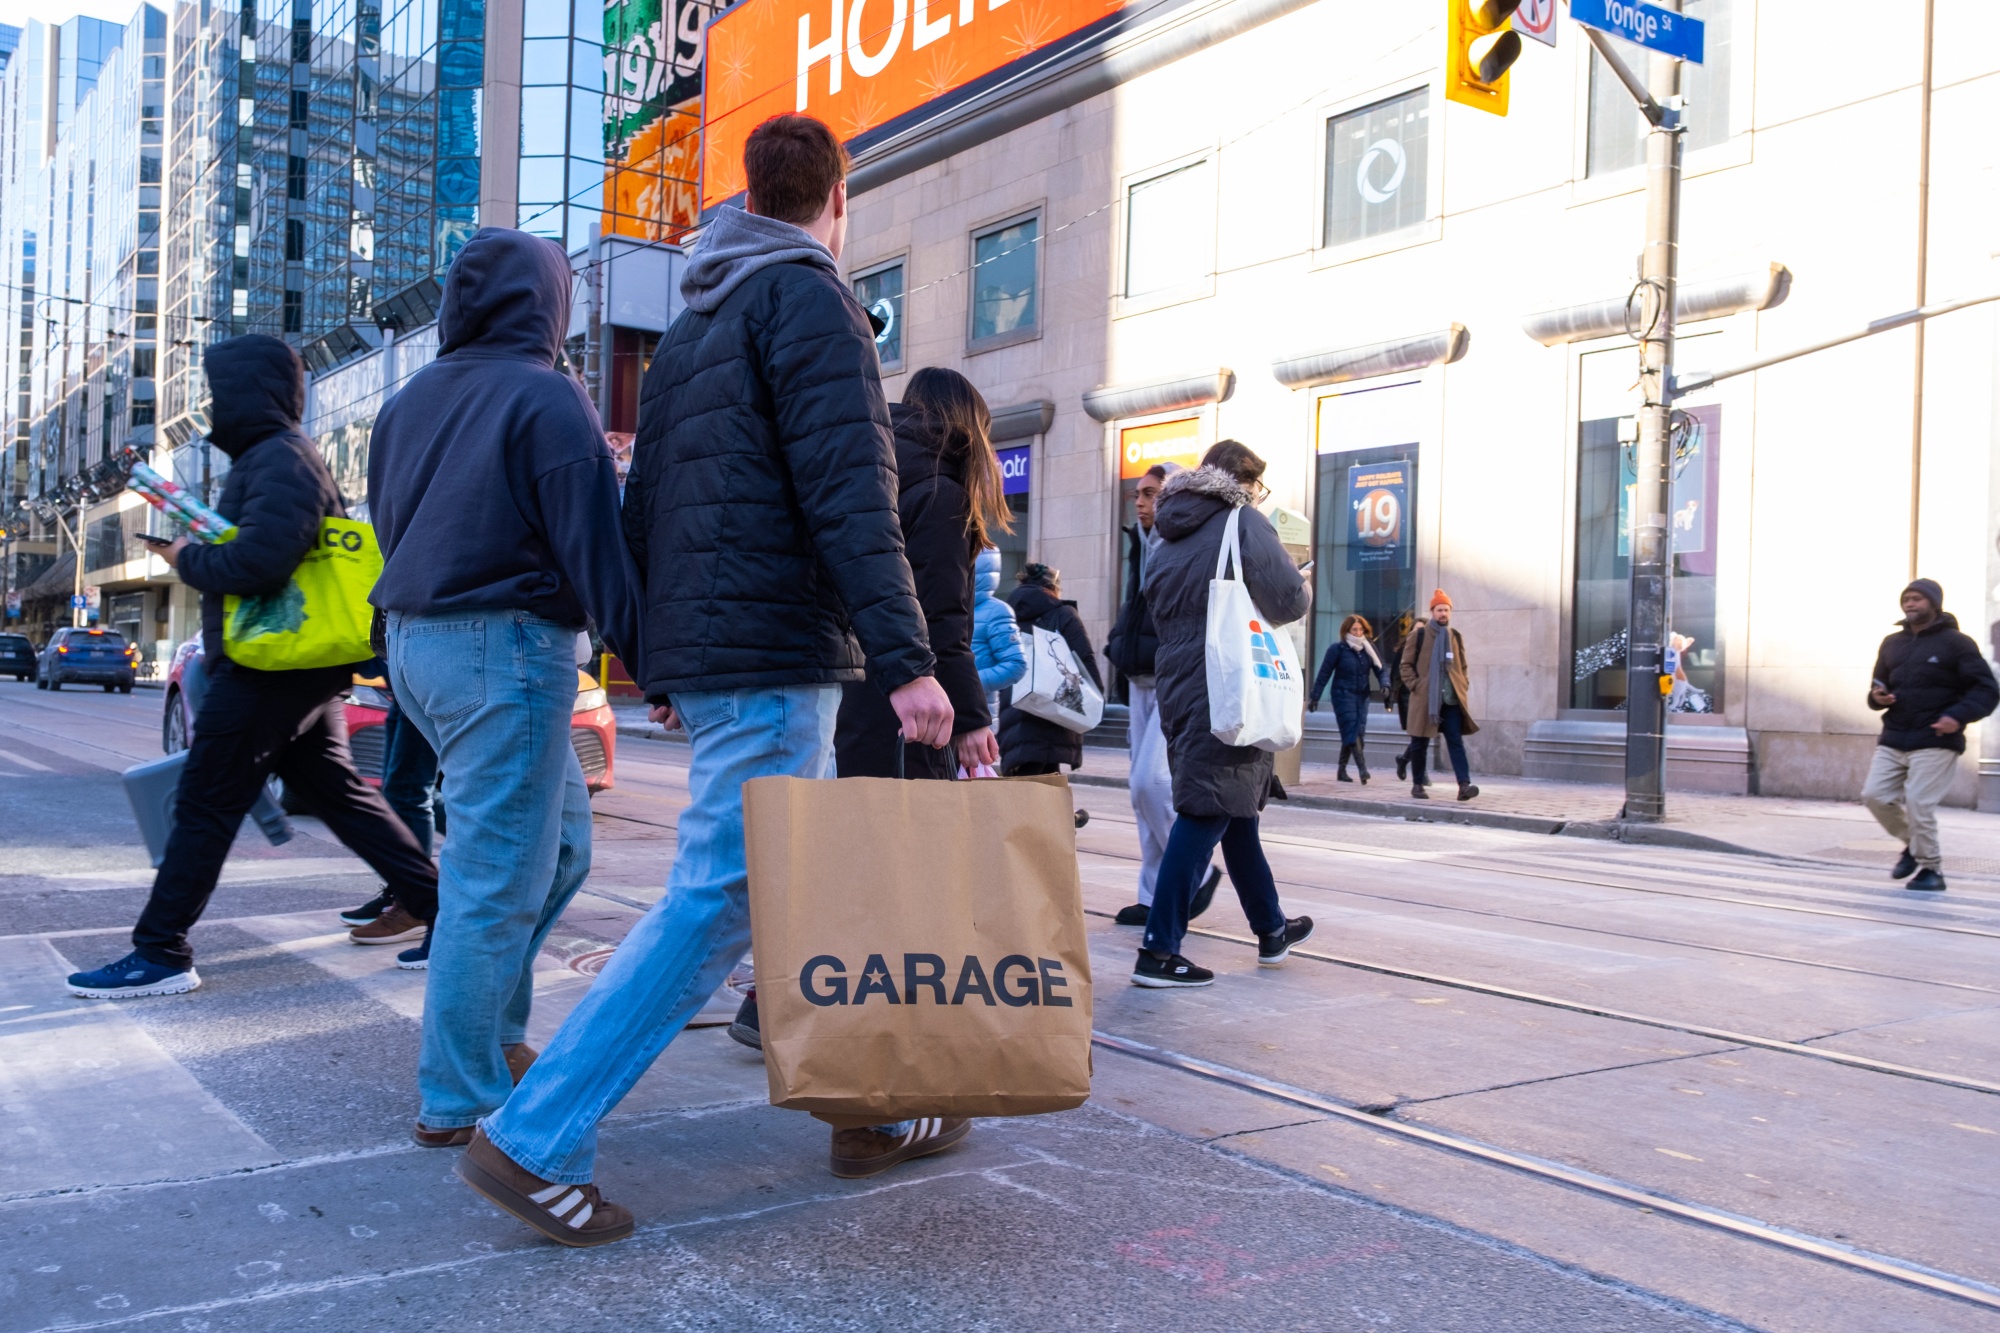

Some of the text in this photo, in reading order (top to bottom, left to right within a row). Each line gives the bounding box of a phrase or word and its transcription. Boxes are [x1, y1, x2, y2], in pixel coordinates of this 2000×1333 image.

[1604, 0, 1673, 43] Yonge St
[800, 953, 1073, 1007] GARAGE
